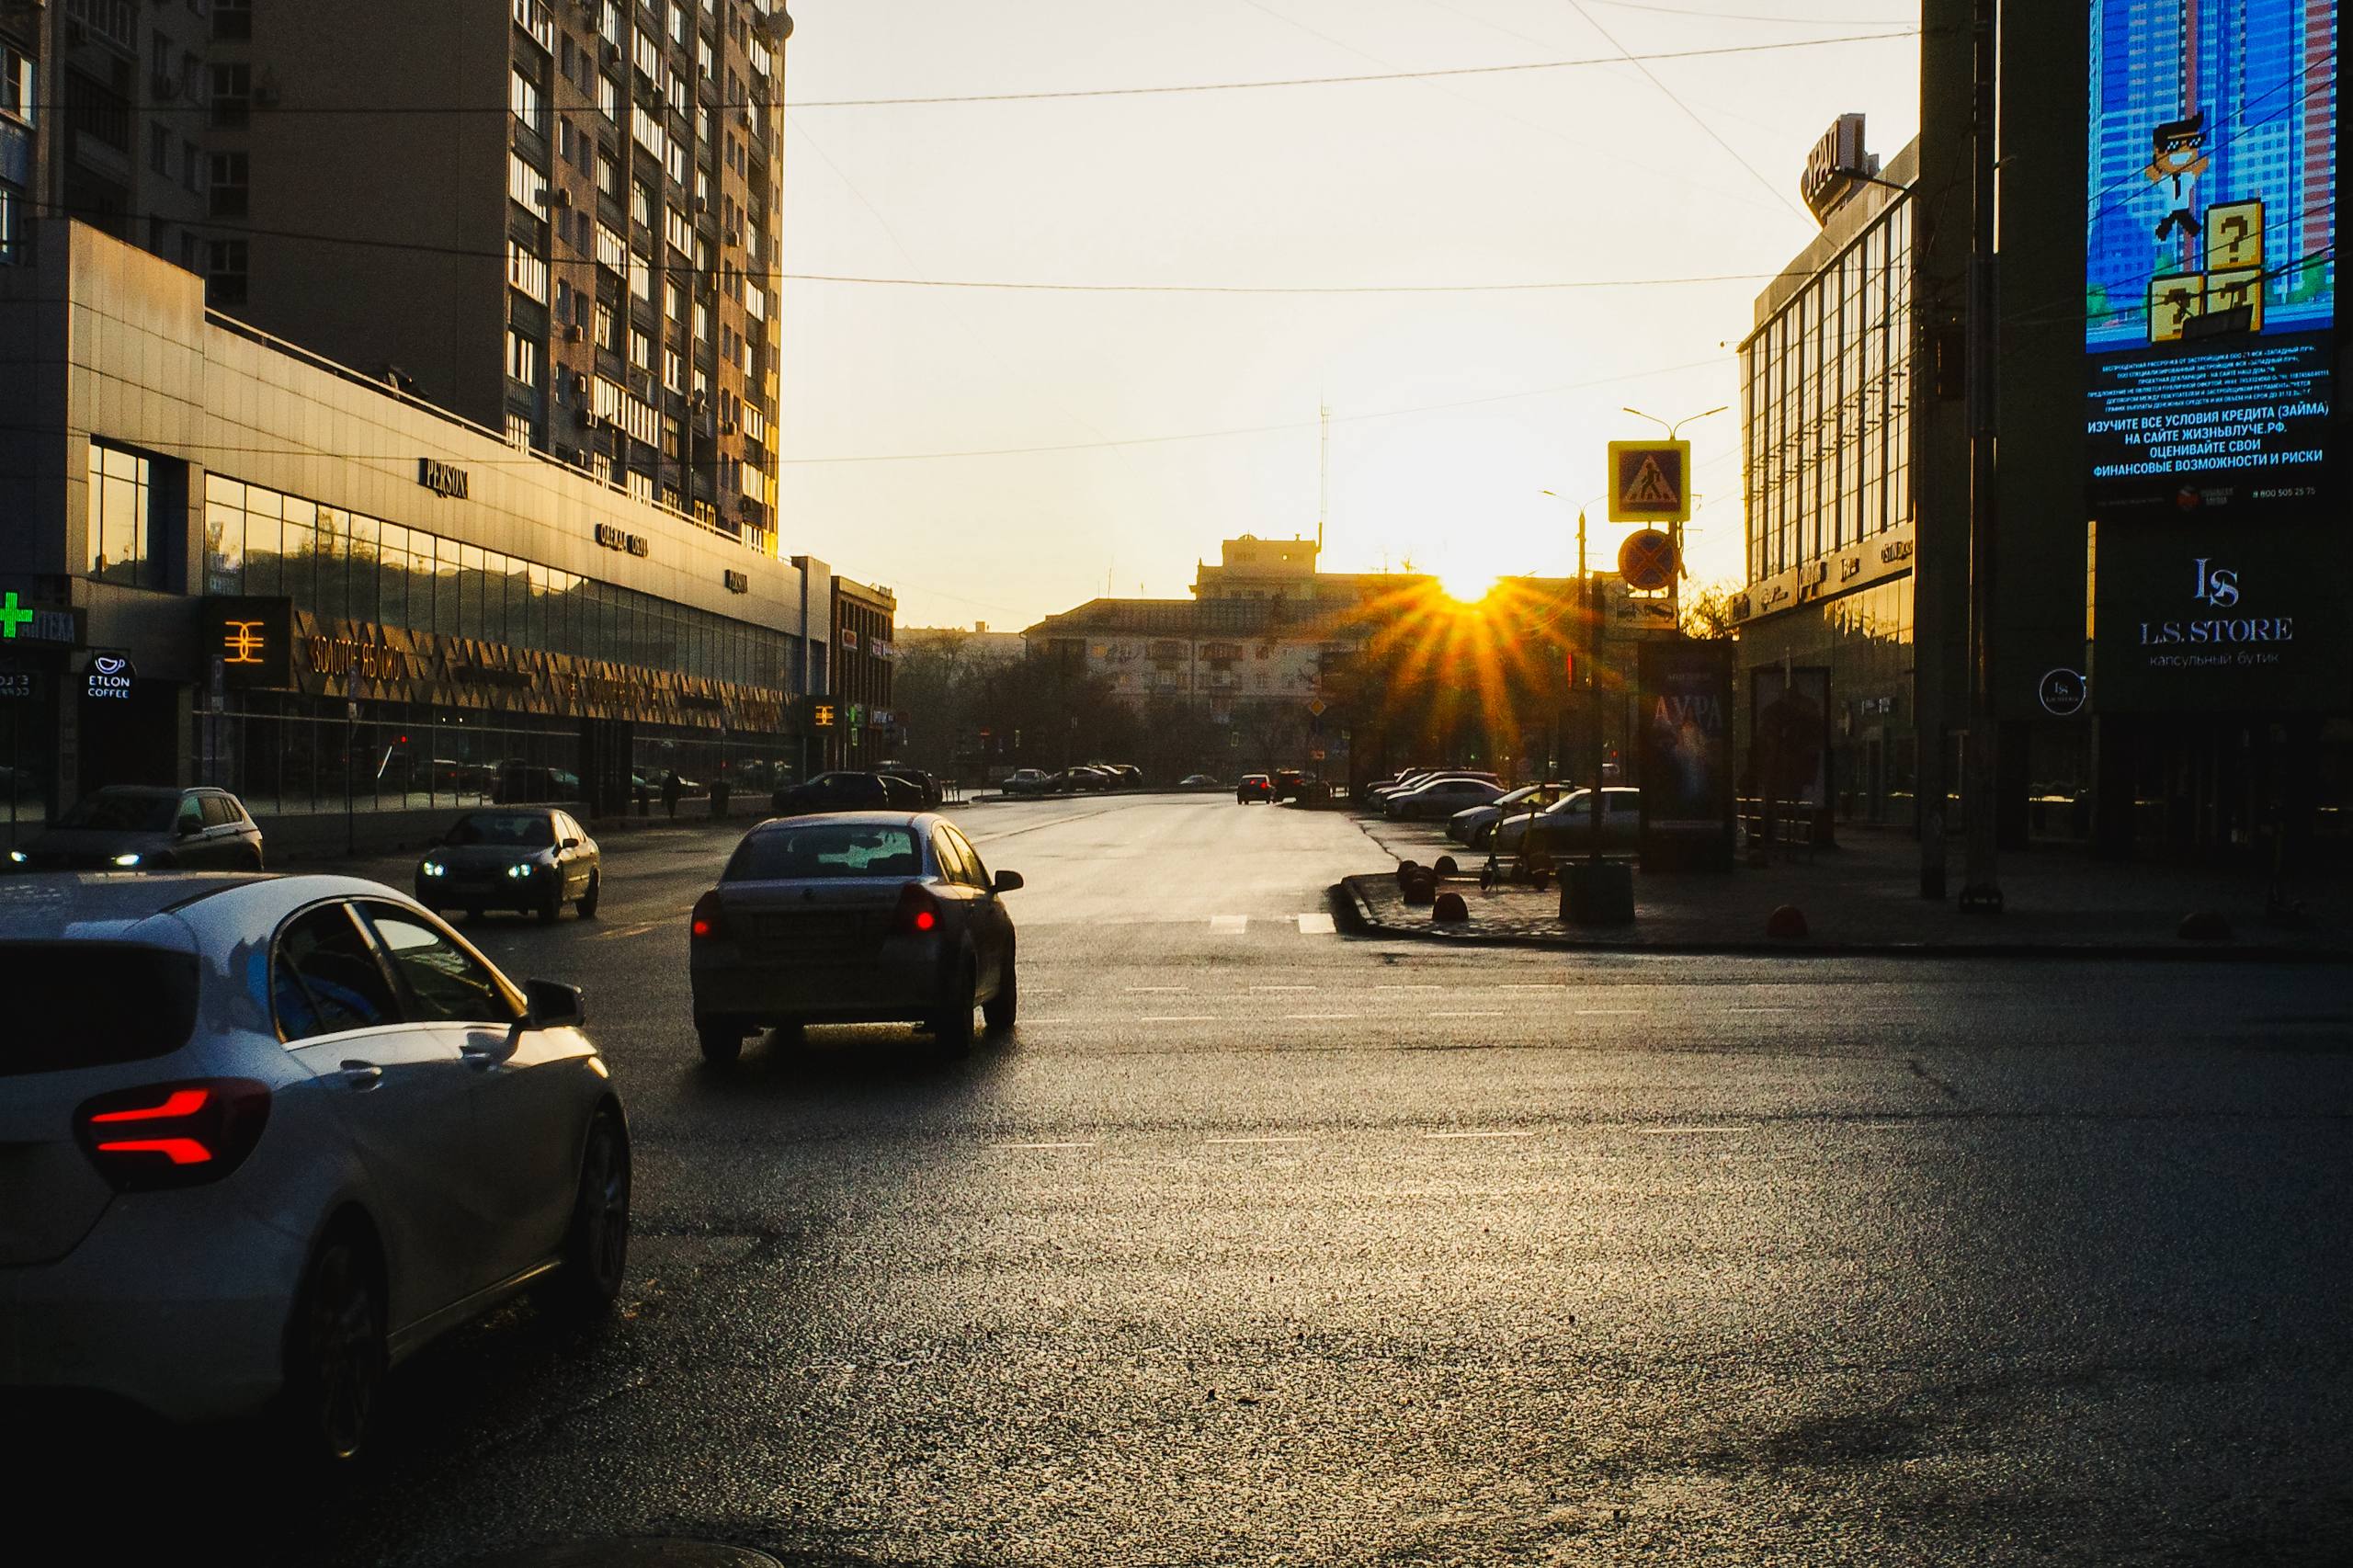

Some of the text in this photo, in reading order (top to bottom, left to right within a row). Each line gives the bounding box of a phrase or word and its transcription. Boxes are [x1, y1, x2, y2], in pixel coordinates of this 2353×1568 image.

[2087, 401, 2329, 434] ИЗУЧИТЕ ВСЕ УСЛОВИЯ КРЕДИТА (ЗАЙМА)
[2125, 432, 2141, 446] НА
[2143, 426, 2179, 443] САЙТЕ
[2150, 439, 2261, 460] ОЦЕНИВАЙТЕ СВОИ
[2093, 449, 2323, 478] ФИНАНСОВЫЕ ВОЗМОЖНОСТИ И РИСКИ
[419, 458, 468, 499] PERSON
[2190, 618, 2293, 642] STORE
[362, 642, 401, 681] ЯБЛОКО
[2150, 651, 2279, 668] капсульный бутик
[89, 676, 131, 687] ETLON
[88, 687, 129, 699] COFFEE
